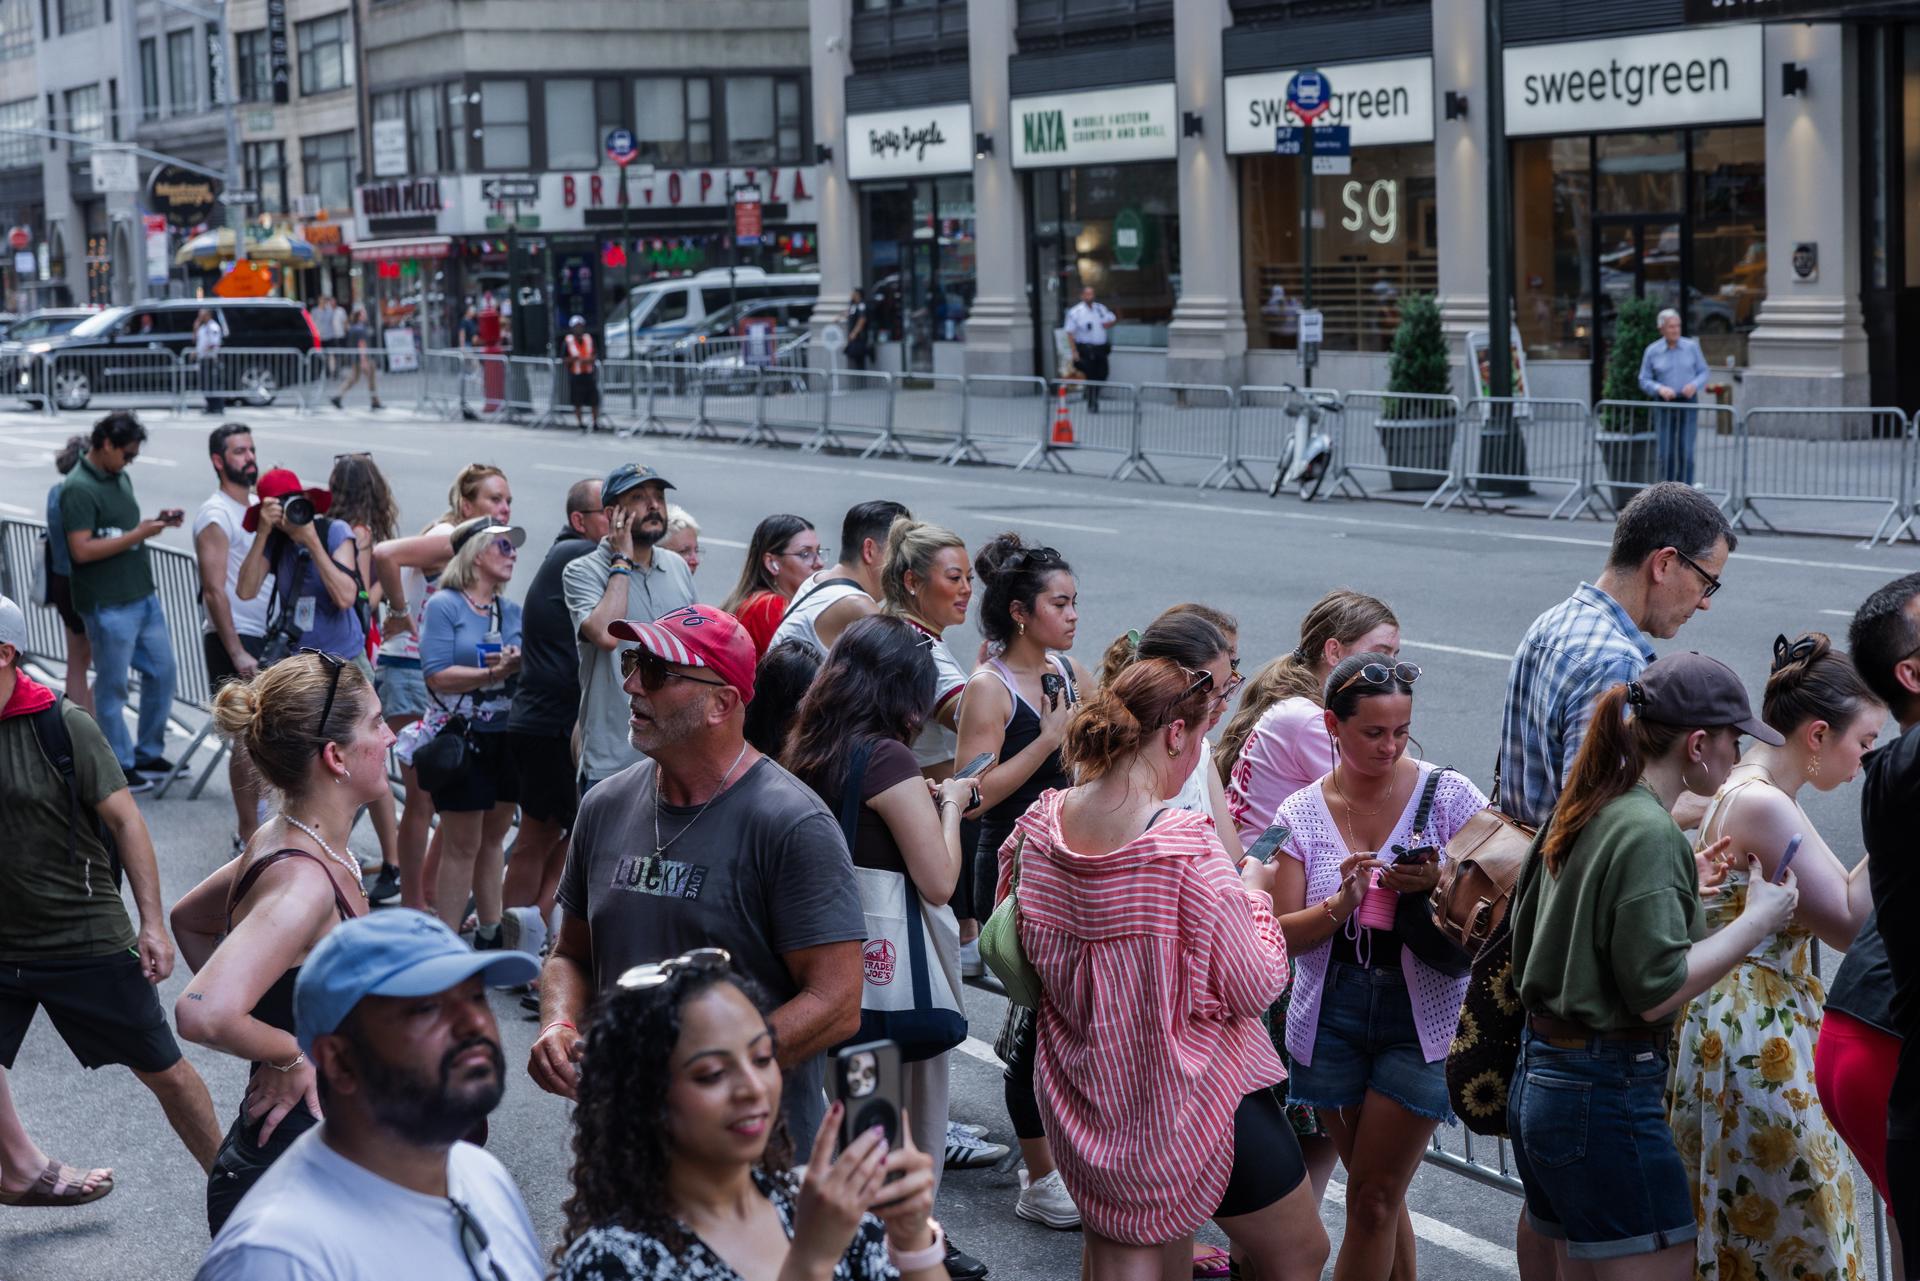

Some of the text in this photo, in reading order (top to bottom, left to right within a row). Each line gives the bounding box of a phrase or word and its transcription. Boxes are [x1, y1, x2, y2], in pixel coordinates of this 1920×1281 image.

[1524, 57, 1729, 106] sweetgreen
[1023, 110, 1067, 154] NAYA
[1117, 127, 1136, 139] AND
[1342, 179, 1397, 244] sg
[614, 858, 687, 892] LUCKY
[685, 866, 706, 900] LOVE
[866, 969, 891, 980] JOE'S
